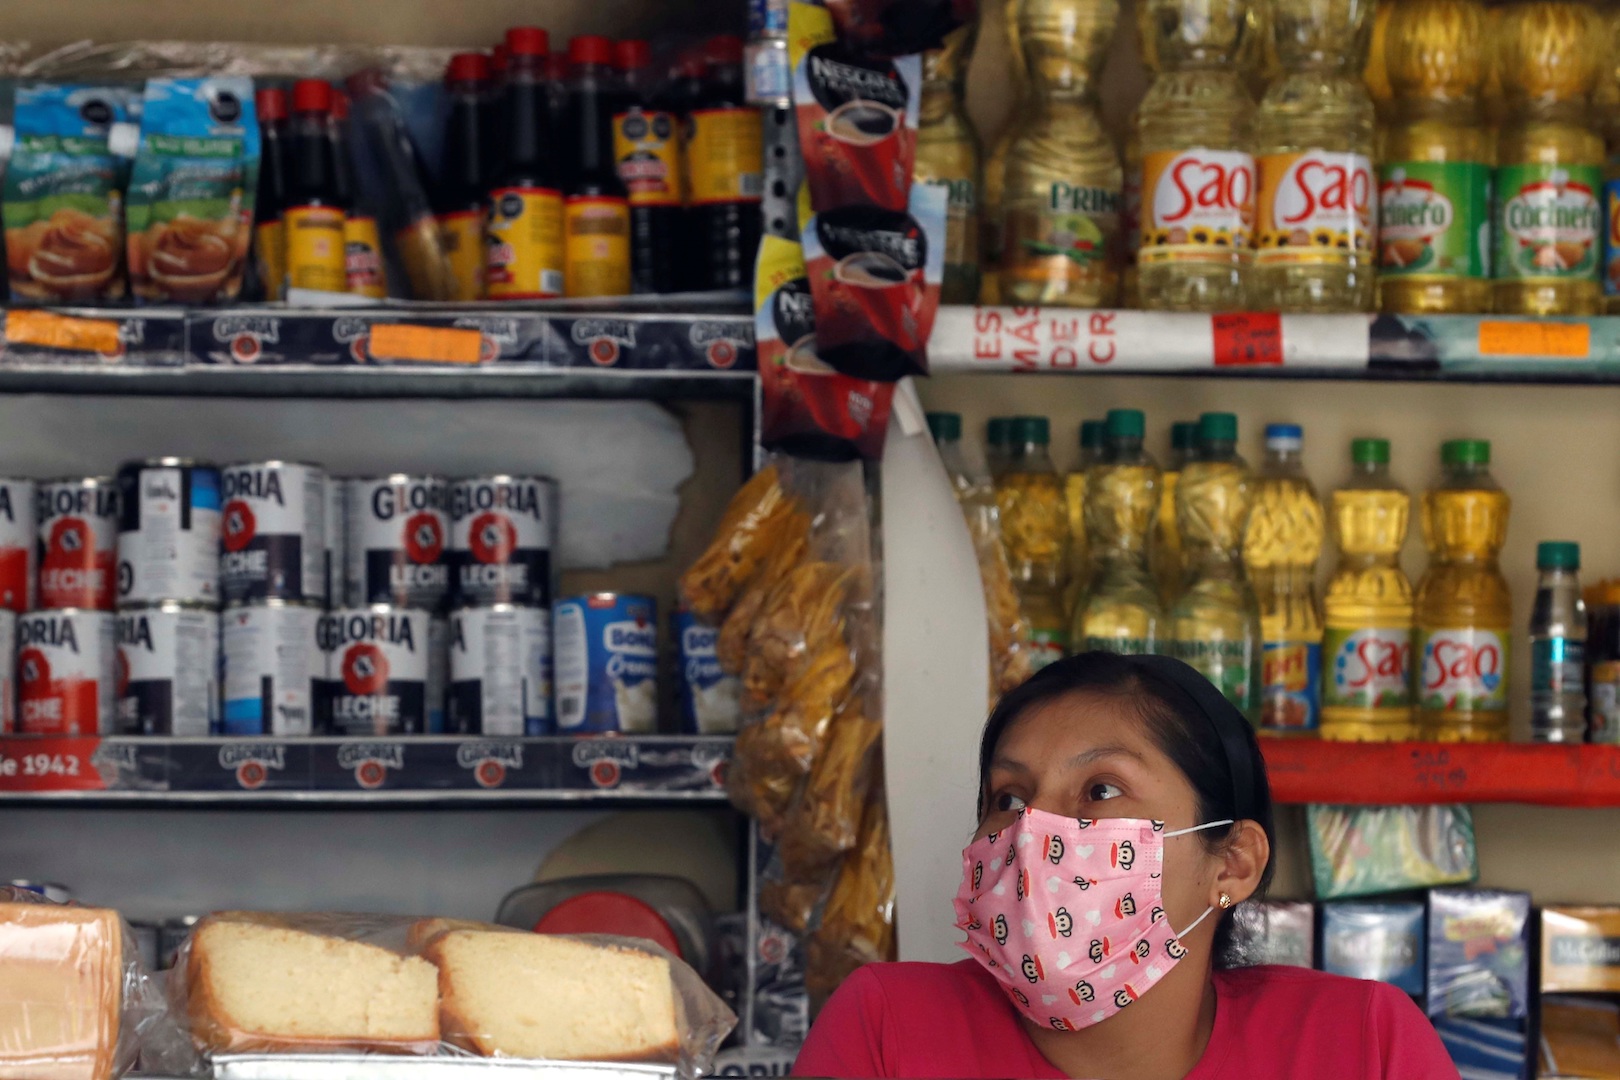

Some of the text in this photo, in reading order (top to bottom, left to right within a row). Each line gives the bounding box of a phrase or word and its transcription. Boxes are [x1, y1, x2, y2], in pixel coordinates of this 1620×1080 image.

[1162, 158, 1253, 222] Sao
[1283, 160, 1370, 223] Sao
[1428, 638, 1498, 690] Sao
[23, 754, 80, 776] 1942
